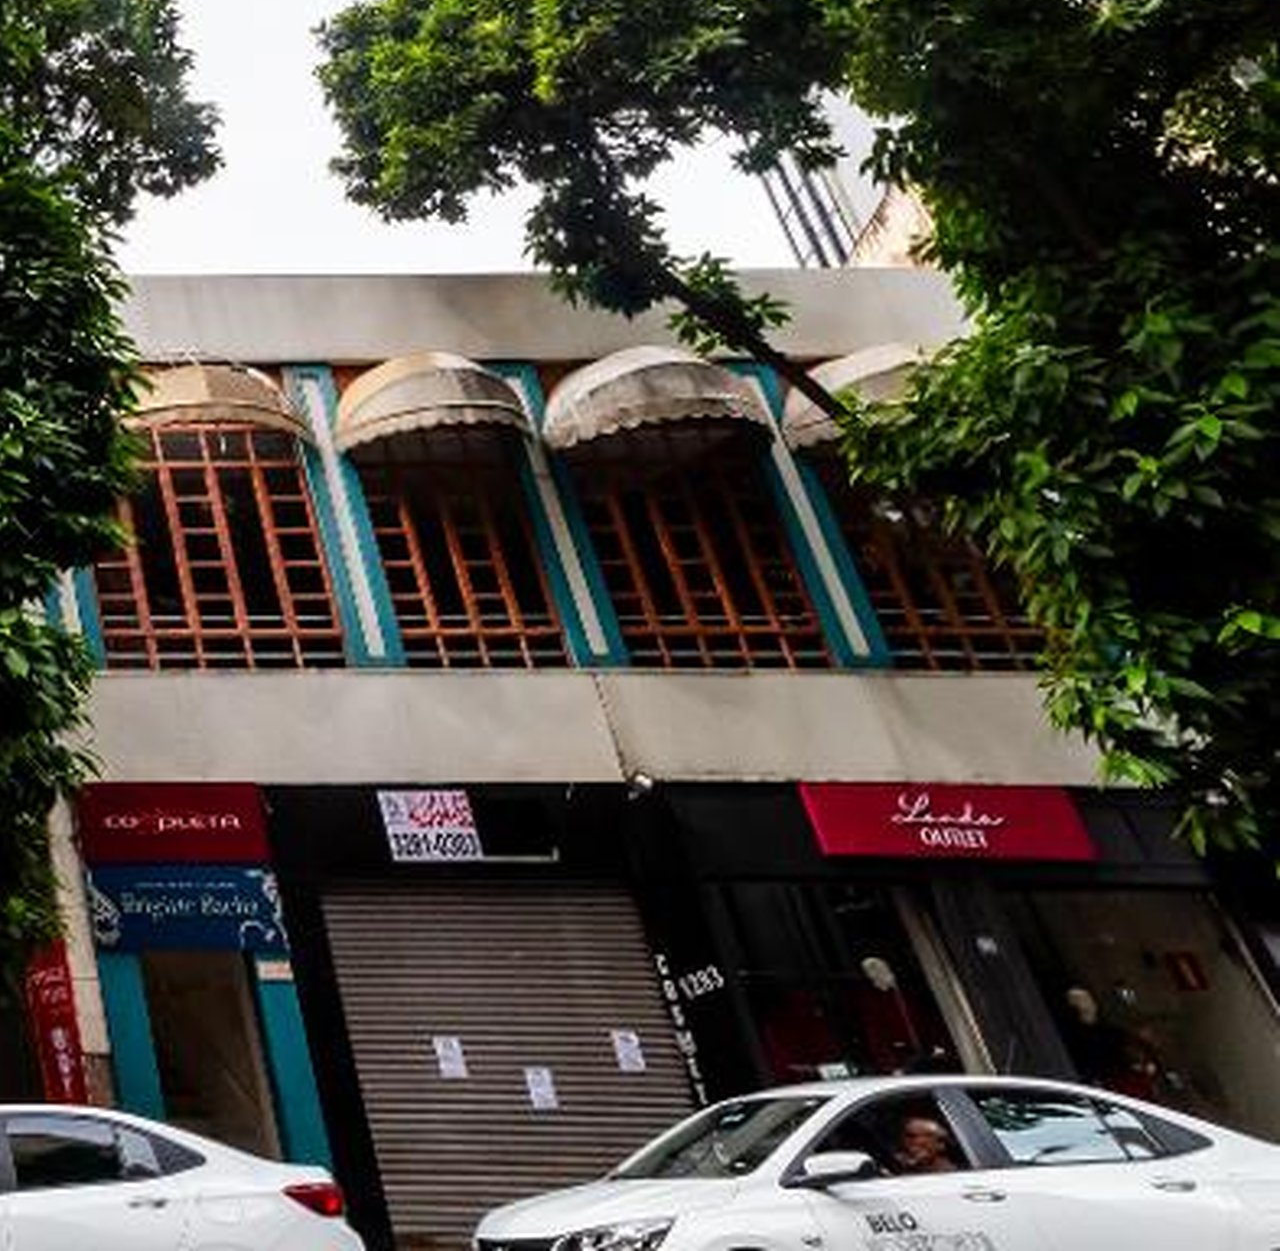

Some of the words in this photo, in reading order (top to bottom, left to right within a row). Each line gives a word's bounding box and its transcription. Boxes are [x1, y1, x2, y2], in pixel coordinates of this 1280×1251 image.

[920, 827, 988, 848] OUTLET
[679, 964, 724, 1000] 1283
[866, 1212, 917, 1234] BELO
